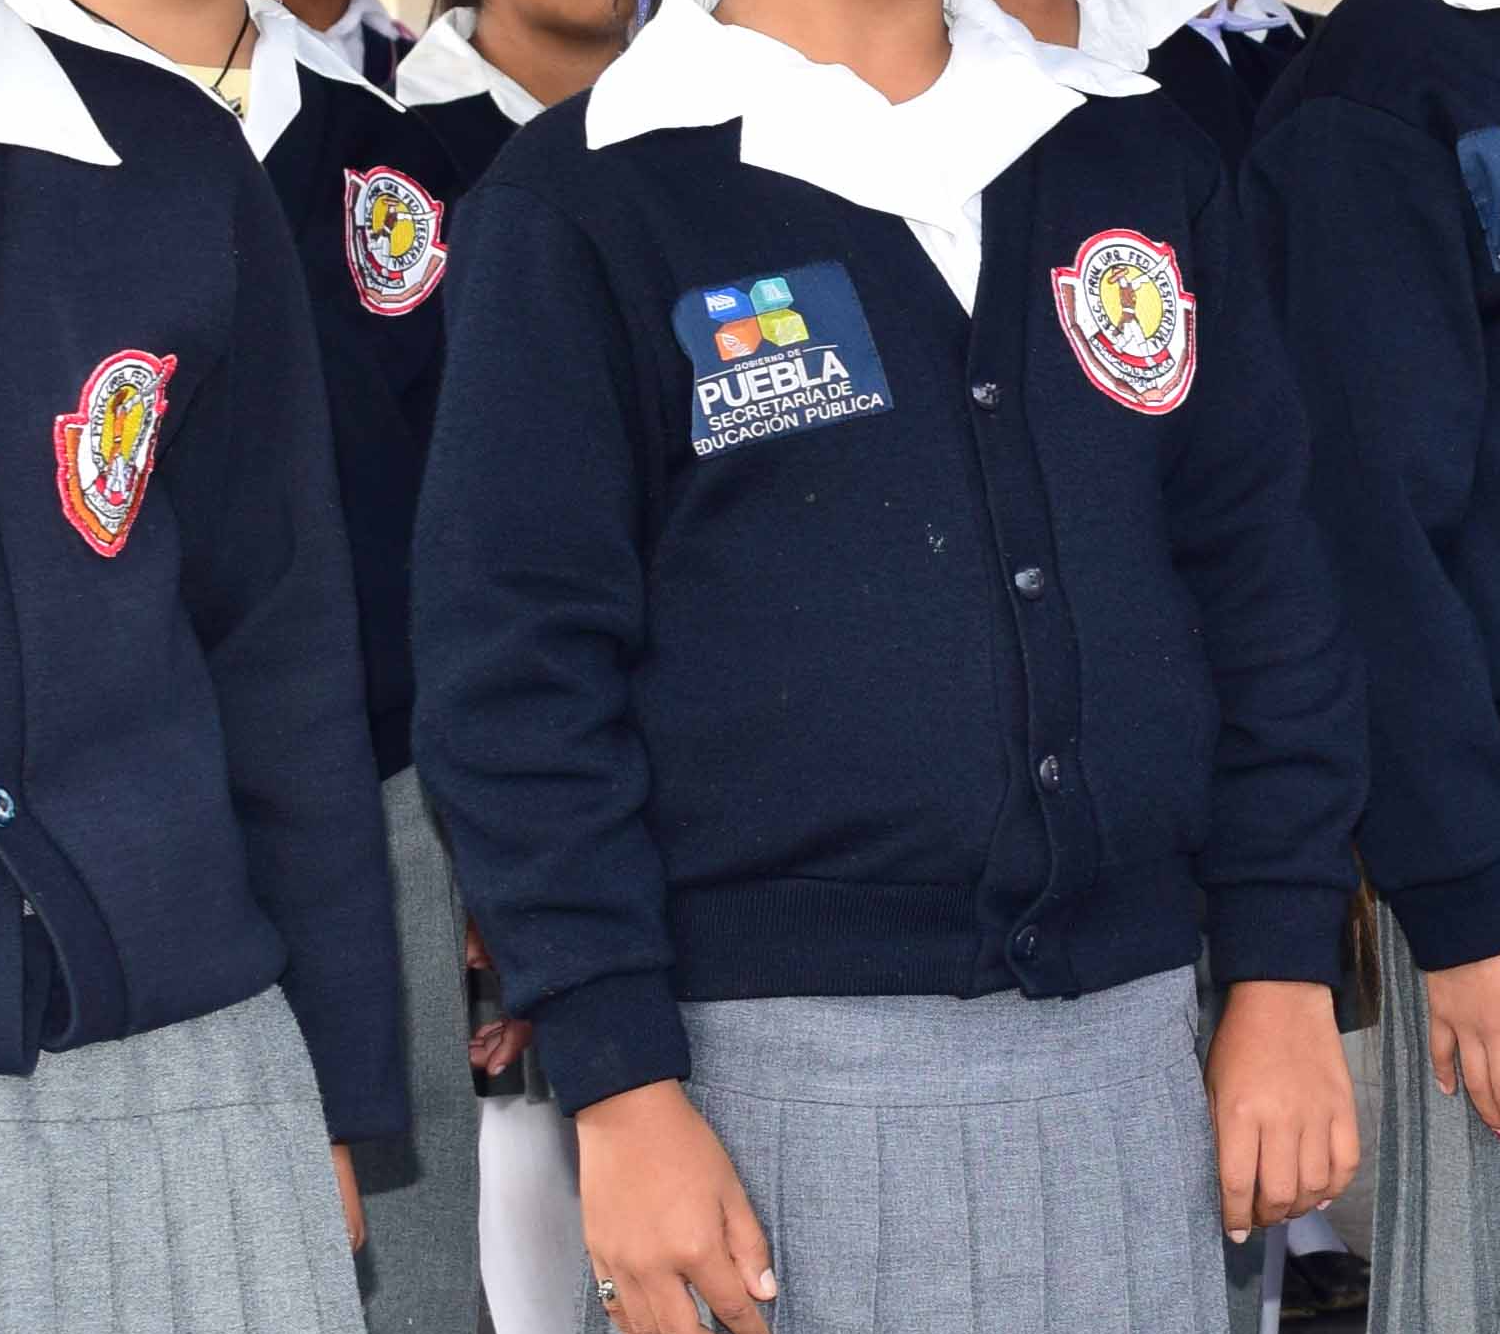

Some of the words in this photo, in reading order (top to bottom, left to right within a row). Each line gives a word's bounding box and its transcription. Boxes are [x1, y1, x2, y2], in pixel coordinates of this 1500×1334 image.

[697, 350, 850, 416] PUEBLA
[733, 353, 786, 373] GOBIERNO
[786, 348, 802, 360] DE
[693, 413, 799, 456] EDUCACIÓN
[804, 392, 884, 424] PÚBLICA
[708, 387, 827, 432] SECRETARÍA
[827, 380, 853, 400] DE
